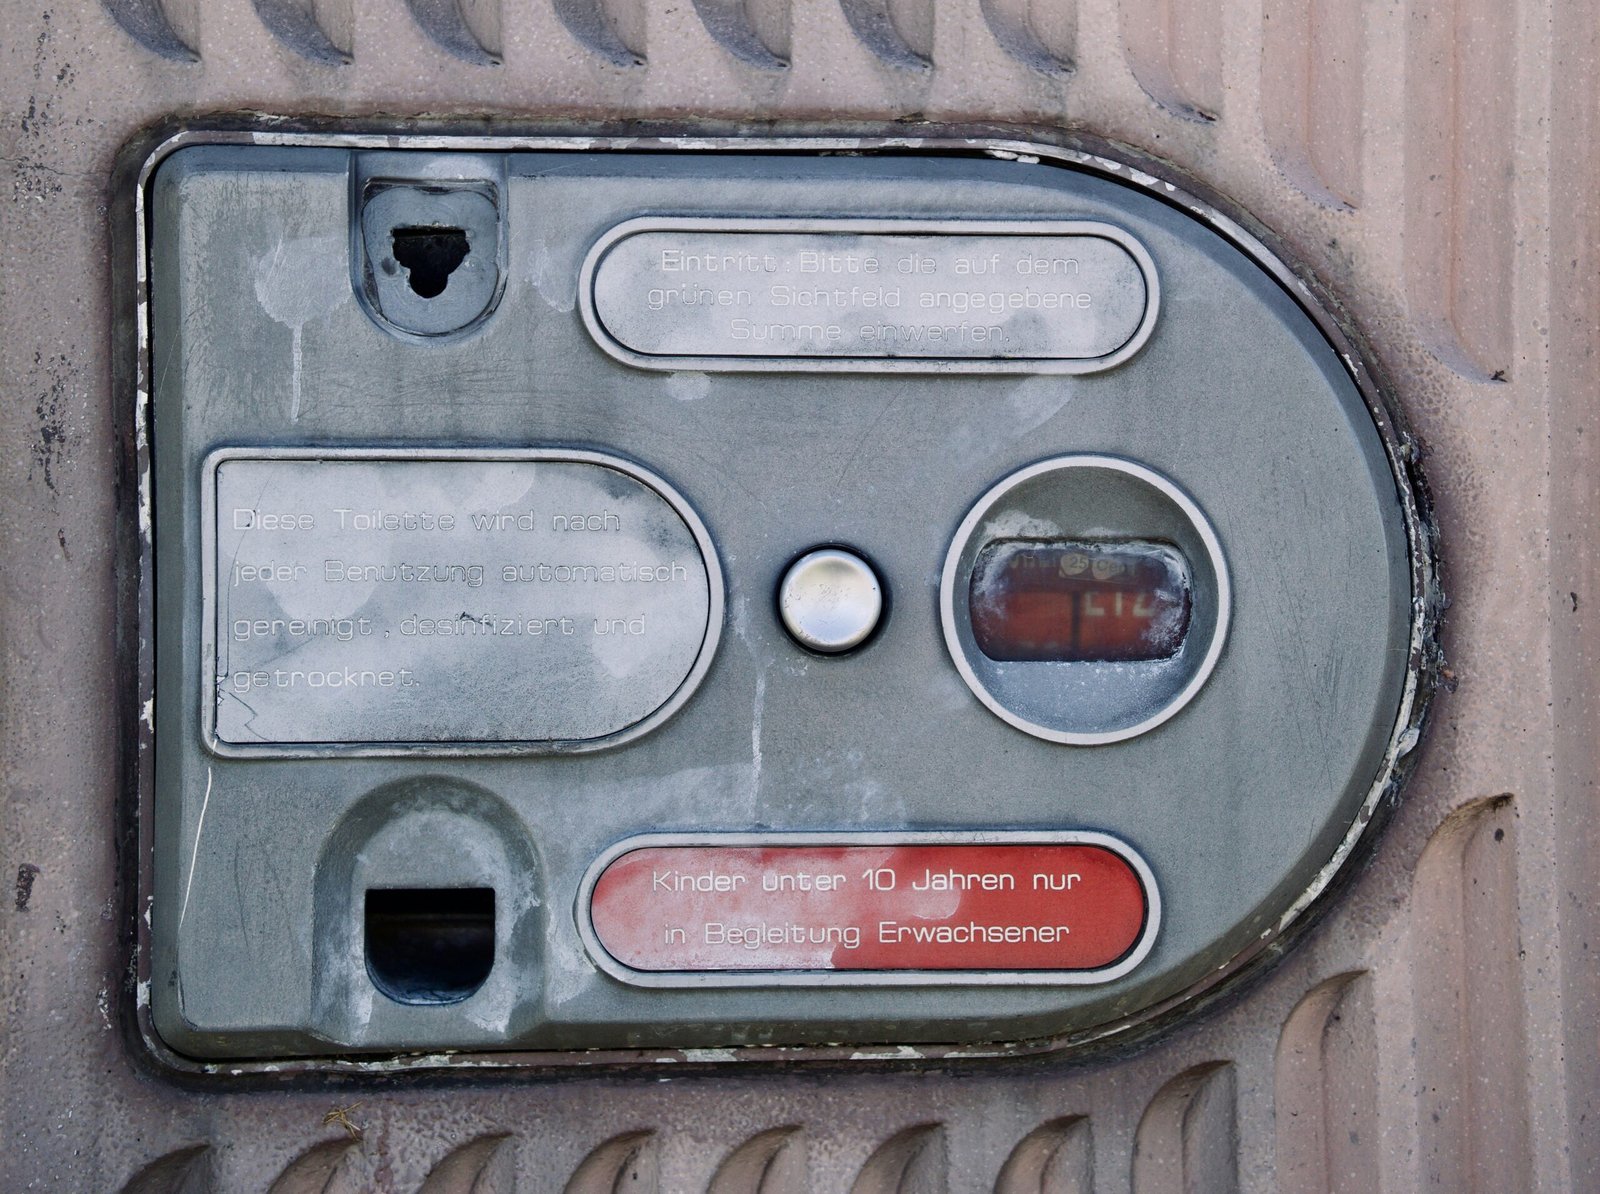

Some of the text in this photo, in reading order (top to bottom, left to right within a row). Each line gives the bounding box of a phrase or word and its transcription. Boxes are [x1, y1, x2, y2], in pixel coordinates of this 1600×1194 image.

[800, 251, 880, 274] Bitte
[897, 253, 937, 275] die
[954, 253, 1001, 275] auf
[1016, 253, 1080, 275] dem
[648, 283, 1093, 314] grünen Sichtfeld angegebene
[730, 318, 1010, 342] Summe einwerfen.
[232, 508, 621, 532] Diese Toilette wird nach
[233, 559, 688, 587] jeder Benutzung automatisch
[400, 613, 575, 636] desinfiziert
[593, 612, 646, 636] und
[232, 666, 421, 693] getrocknet.
[652, 868, 1081, 892] Kinder unter 10 Jahren nur
[664, 921, 1070, 949] in Begleitung Erwachsener
